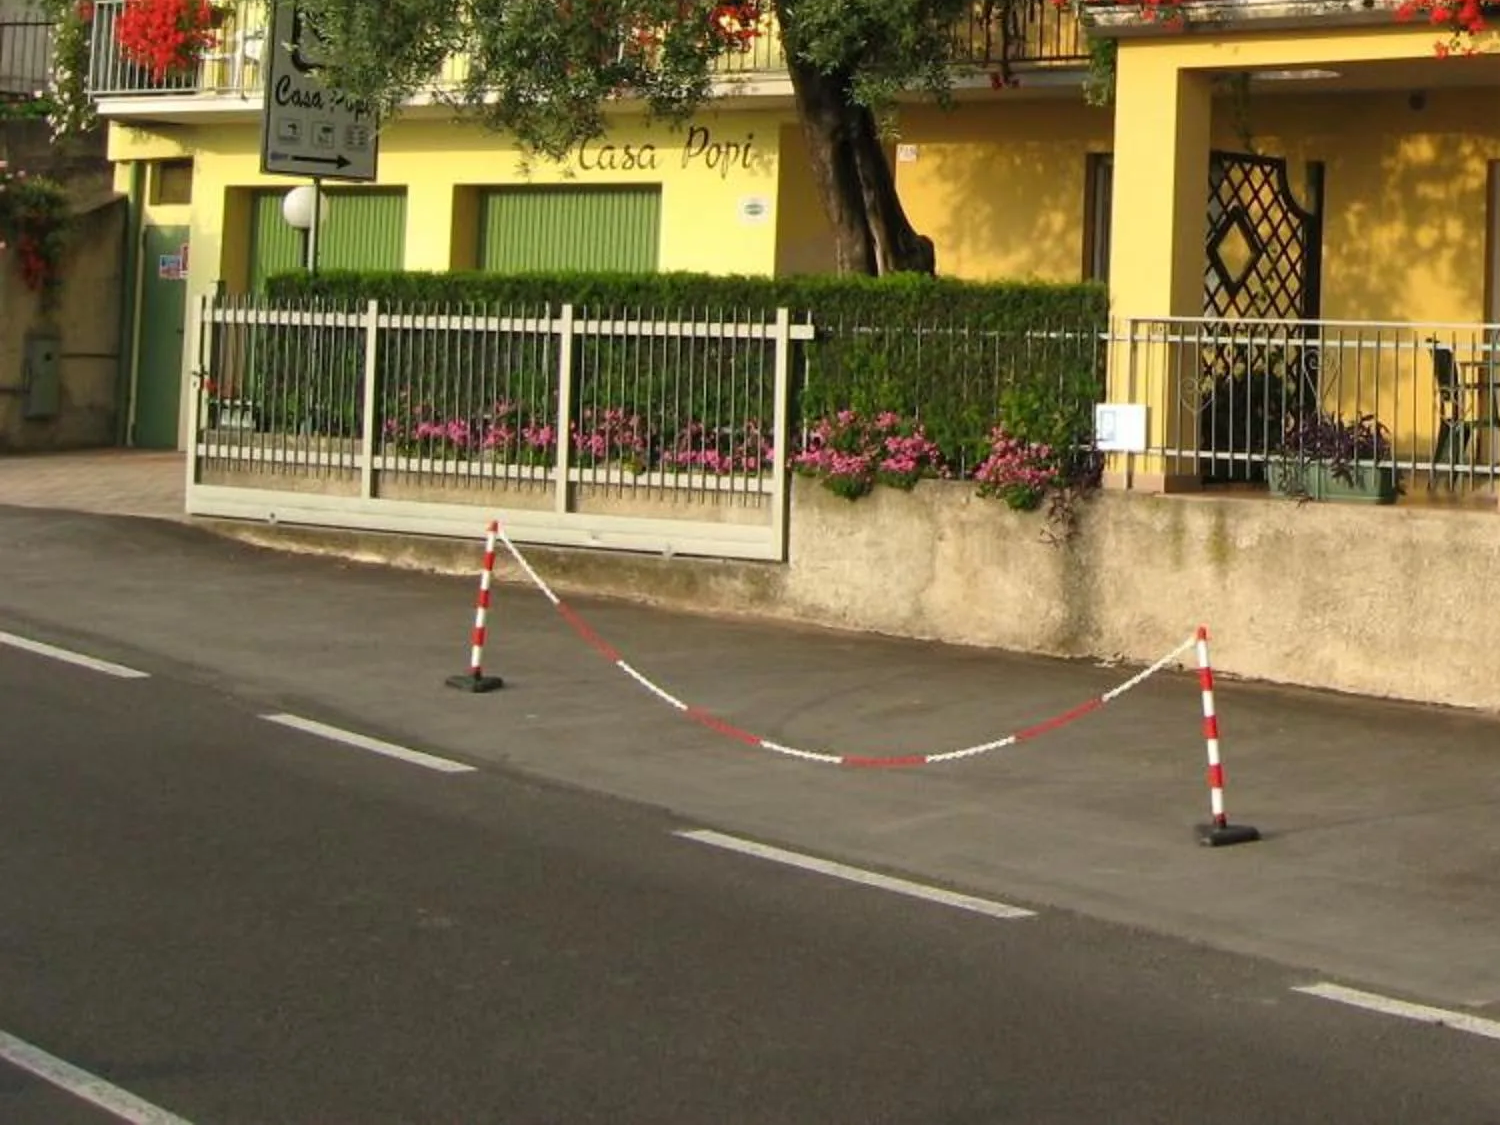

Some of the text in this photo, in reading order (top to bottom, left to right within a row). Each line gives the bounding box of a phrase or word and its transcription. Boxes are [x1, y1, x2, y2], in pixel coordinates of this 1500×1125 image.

[275, 75, 324, 110] Casa
[578, 125, 755, 180] Casa Popi
